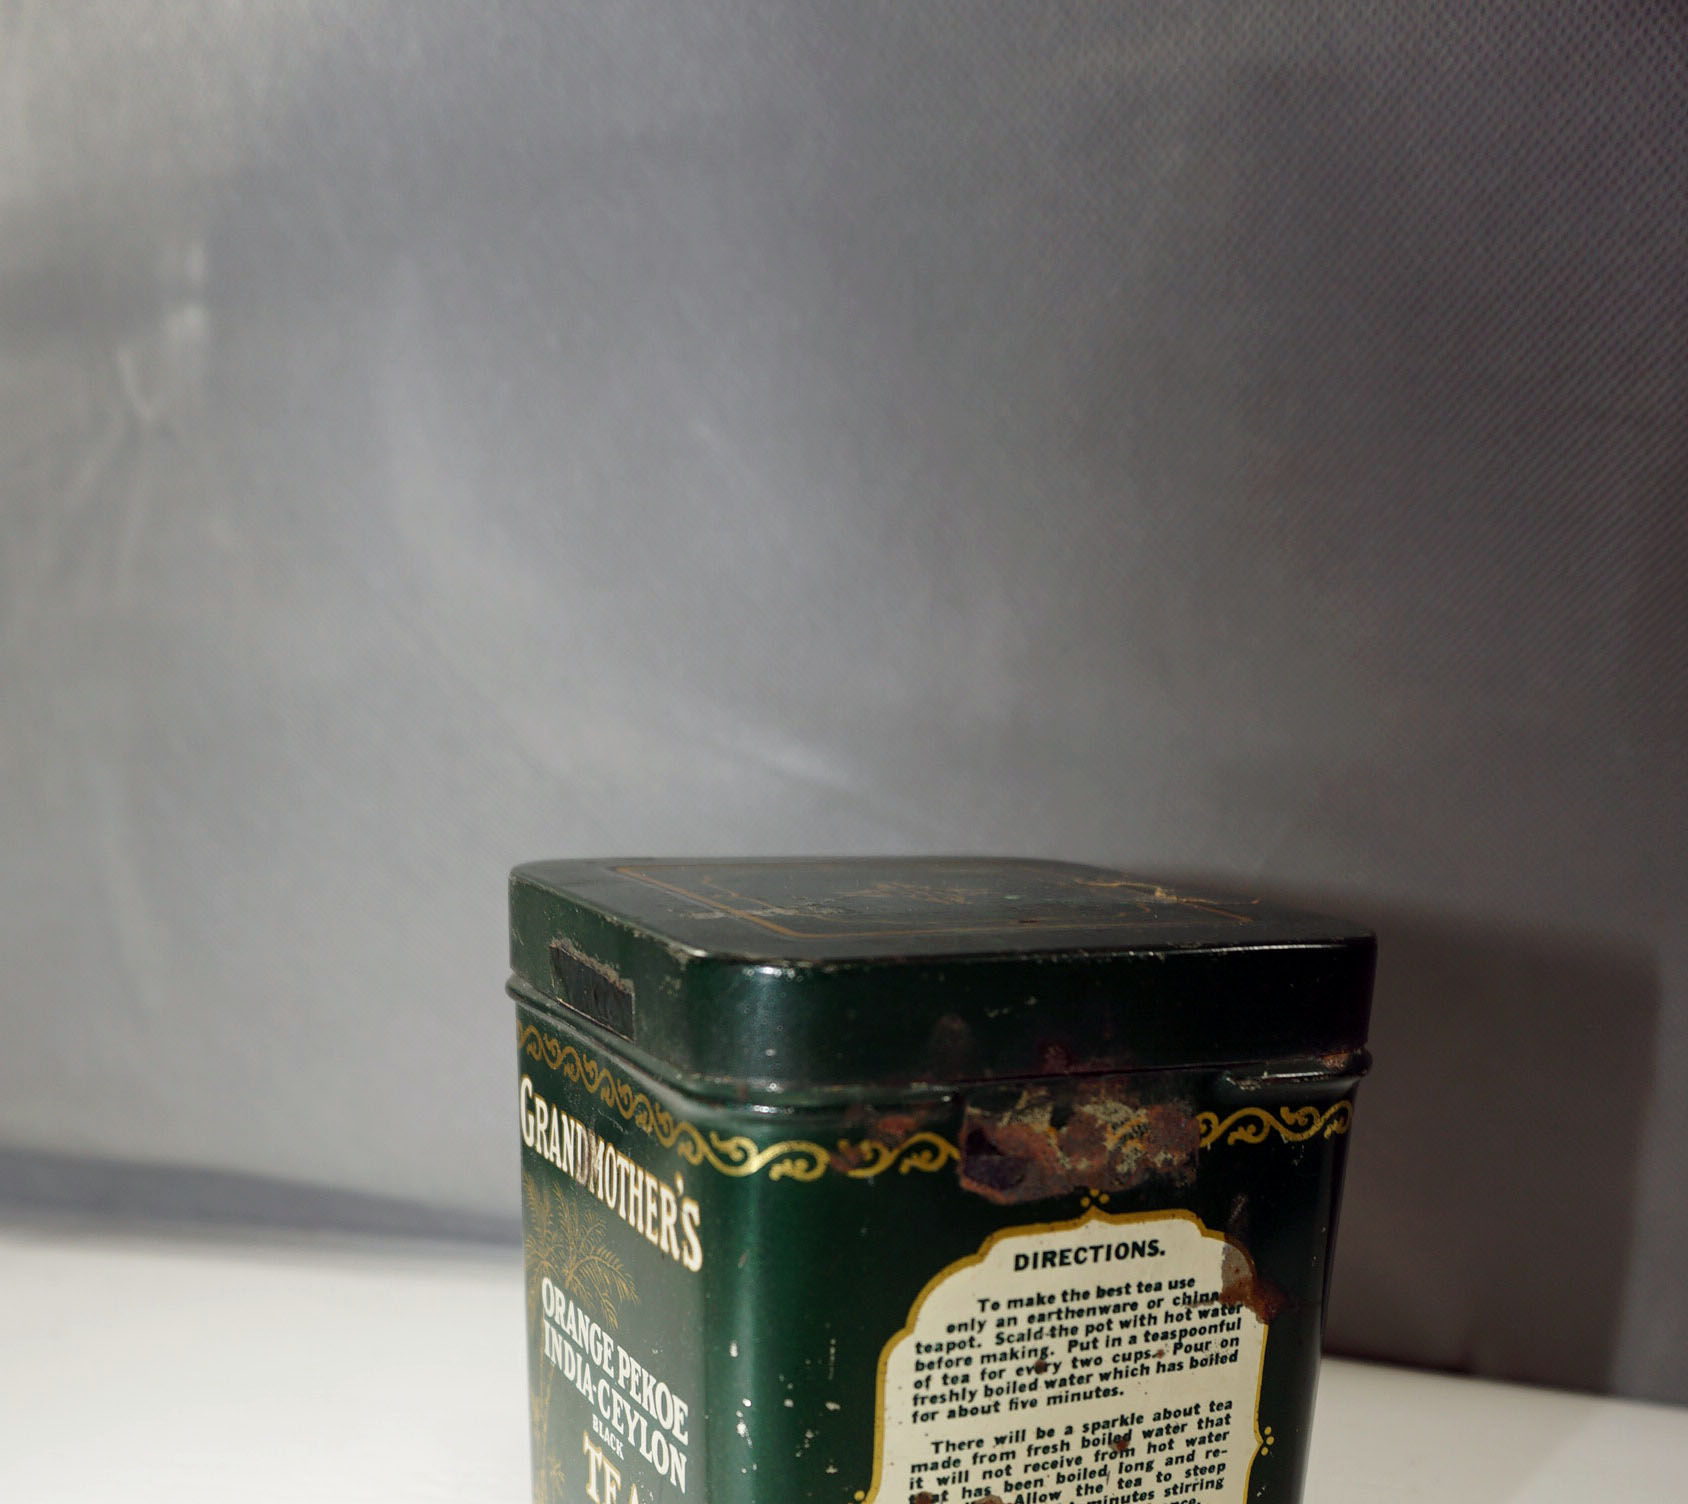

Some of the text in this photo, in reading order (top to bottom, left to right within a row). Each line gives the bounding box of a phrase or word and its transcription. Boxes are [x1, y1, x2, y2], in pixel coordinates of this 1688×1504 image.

[520, 1075, 702, 1272] GRANDMOTHER'S
[1014, 1239, 1166, 1271] DIRECTIONS.
[946, 1289, 1219, 1336] only an earthenware or china
[978, 1276, 1196, 1312] To make the best tea use
[915, 1302, 1243, 1354] teapot. Scald the pot with hot water
[915, 1318, 1241, 1372] before making. Put in a teaspoonful
[541, 1277, 689, 1446] ORANGE PEKOE
[913, 1350, 1239, 1405] freshly boiled water which has boiled
[914, 1375, 931, 1390] of
[942, 1372, 970, 1385] tea
[980, 1365, 1005, 1381] for
[1071, 1355, 1102, 1368] two
[1112, 1346, 1158, 1364] cups.
[1172, 1340, 1211, 1355] Pour
[1220, 1336, 1240, 1348] on
[912, 1386, 1124, 1424] for about five minutes.
[931, 1399, 1232, 1455] There will be a sparkle about tea
[592, 1413, 624, 1461] BLACK
[909, 1430, 1230, 1490] it will not receive from hot water
[910, 1413, 1232, 1473] made from fresh boiled water that
[961, 1485, 991, 1500] has
[1003, 1477, 1044, 1495] been
[1057, 1465, 1108, 1484] boiled
[1118, 1457, 1154, 1476] long
[1165, 1451, 1195, 1466] and
[1205, 1449, 1228, 1461] re-
[1076, 1482, 1104, 1496] the
[1117, 1475, 1142, 1491] tea
[1156, 1470, 1172, 1483] to
[1185, 1461, 1226, 1482] steep
[1163, 1476, 1224, 1498] stirring
